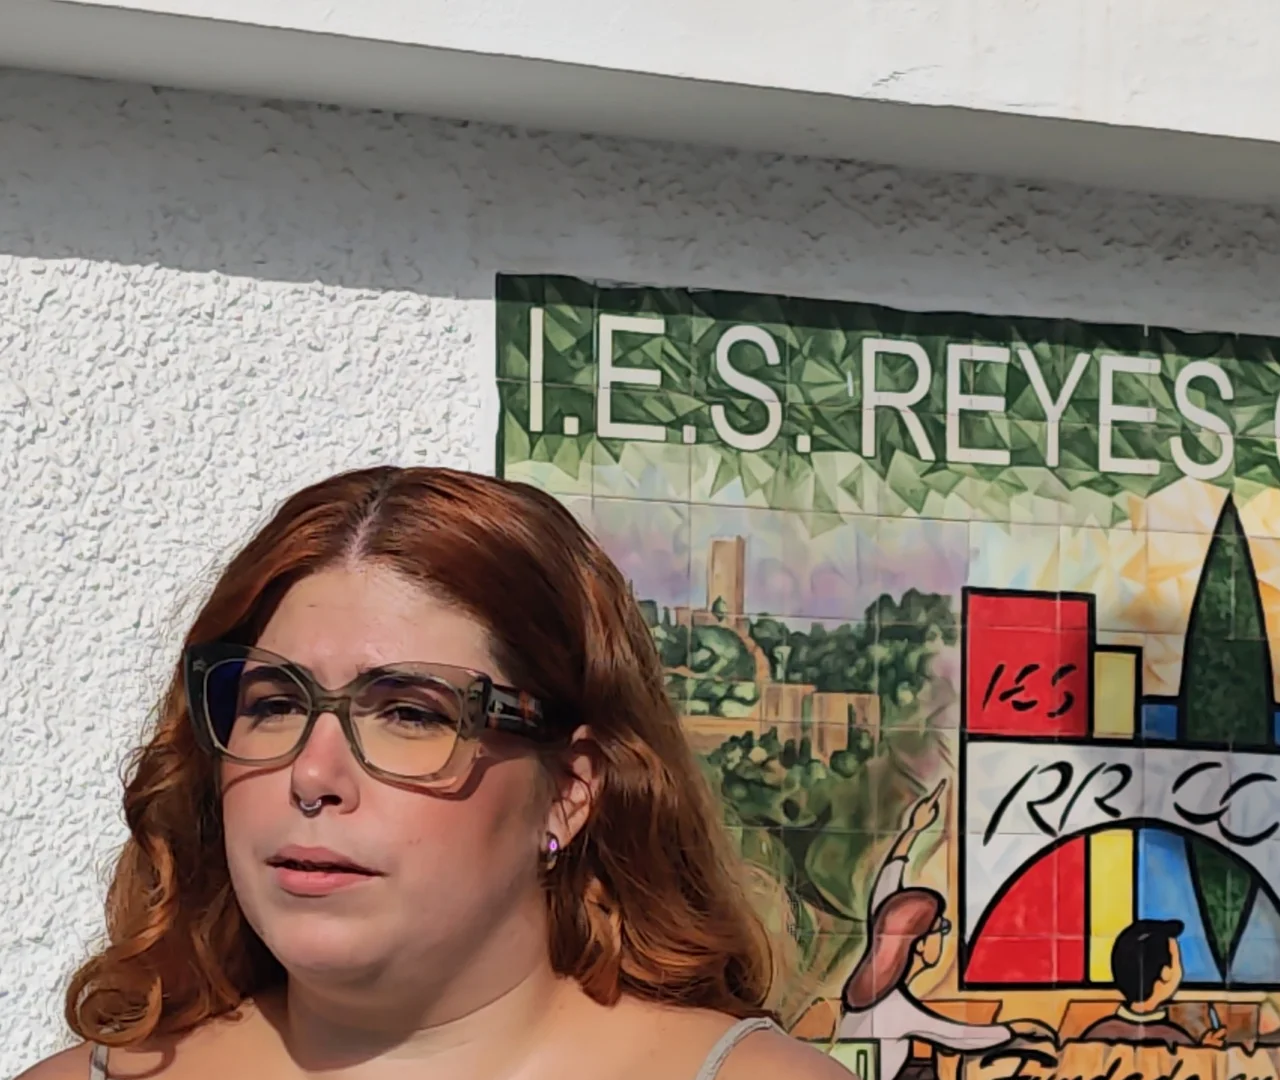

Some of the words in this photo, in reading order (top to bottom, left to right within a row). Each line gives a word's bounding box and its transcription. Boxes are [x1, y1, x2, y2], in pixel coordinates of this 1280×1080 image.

[528, 307, 811, 453] I.E.S.
[860, 338, 1235, 480] REYES
[981, 663, 1078, 719] IES
[982, 760, 1133, 847] RR
[1171, 761, 1280, 847] CC
